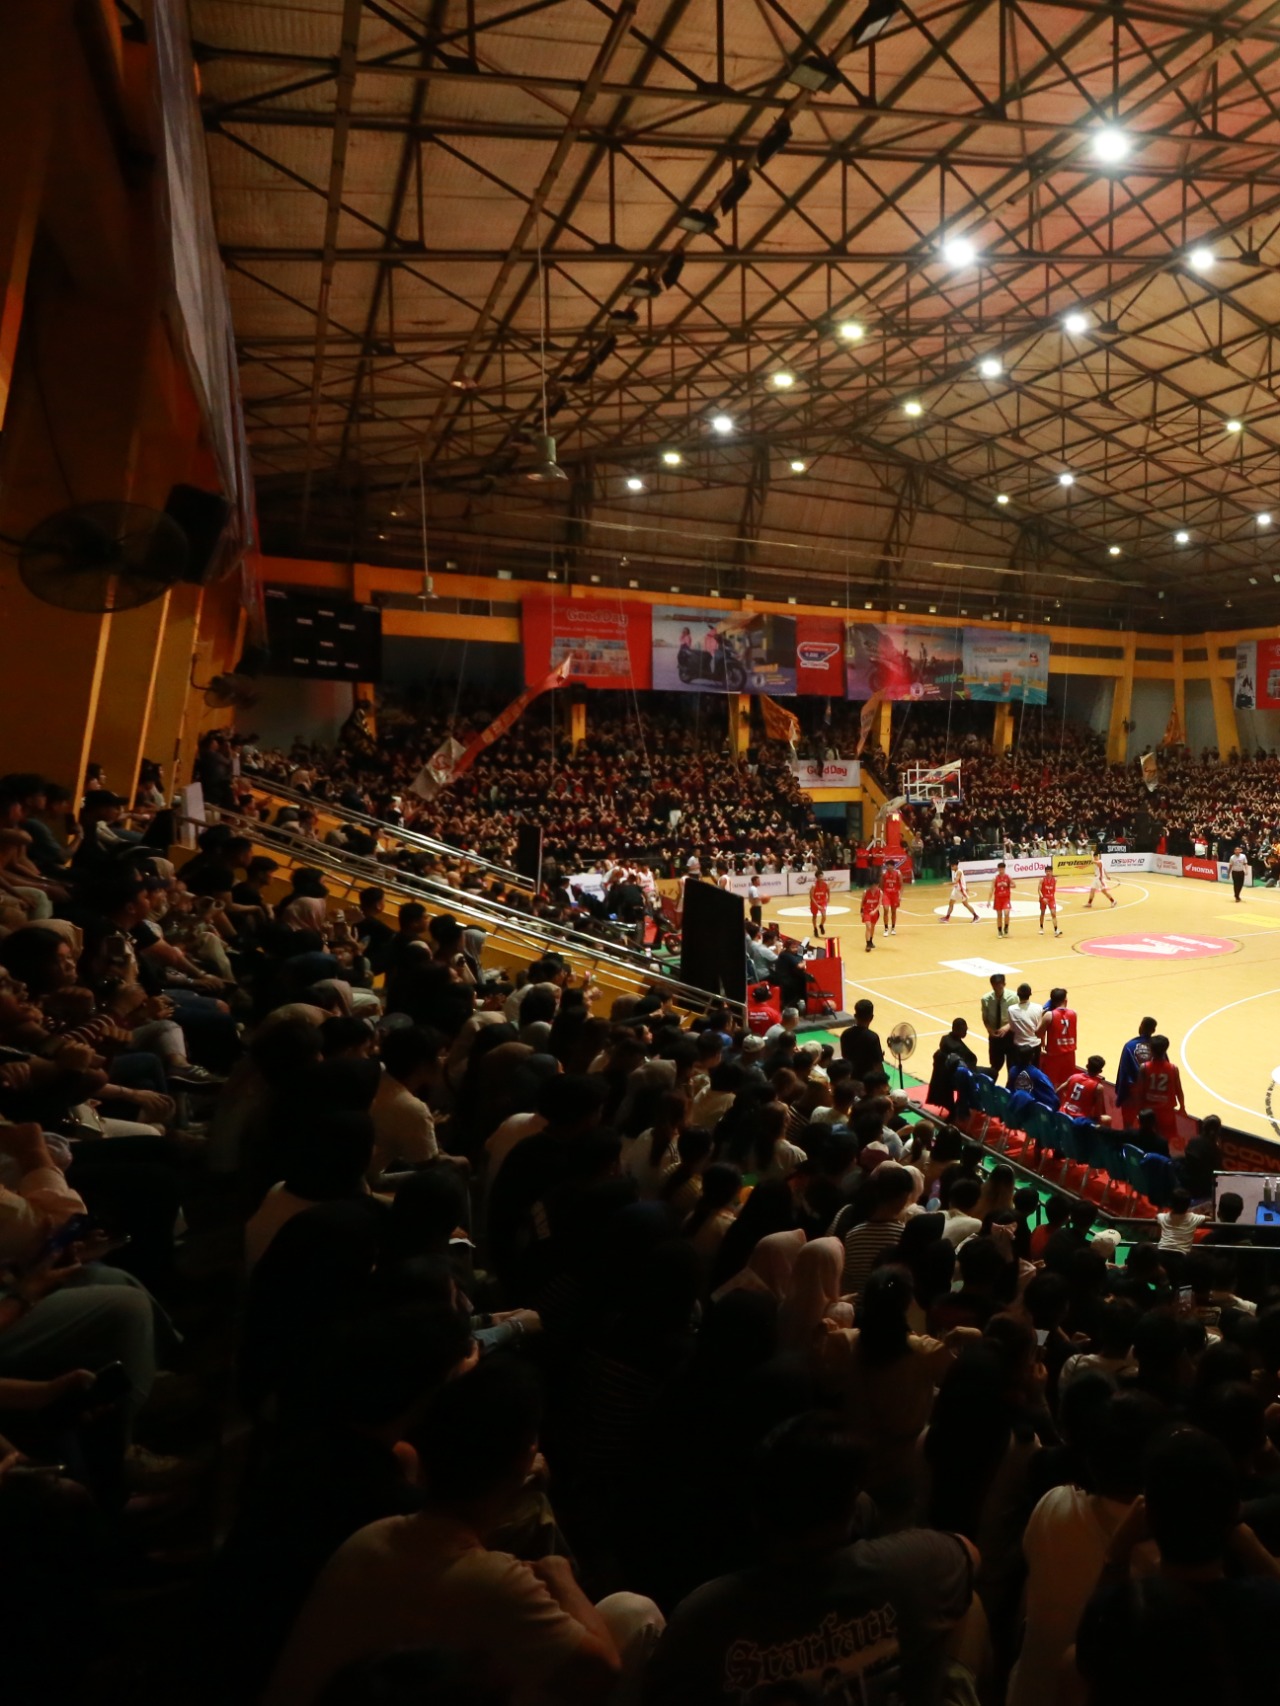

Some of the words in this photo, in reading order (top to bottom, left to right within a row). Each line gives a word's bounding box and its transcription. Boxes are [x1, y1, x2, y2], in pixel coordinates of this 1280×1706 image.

[1014, 863, 1034, 873] Good
[1191, 865, 1214, 875] HONDA
[1060, 1019, 1070, 1036] 7
[1149, 1072, 1169, 1092] 12
[1070, 1083, 1085, 1102] 5
[722, 1600, 899, 1692] Scarface
